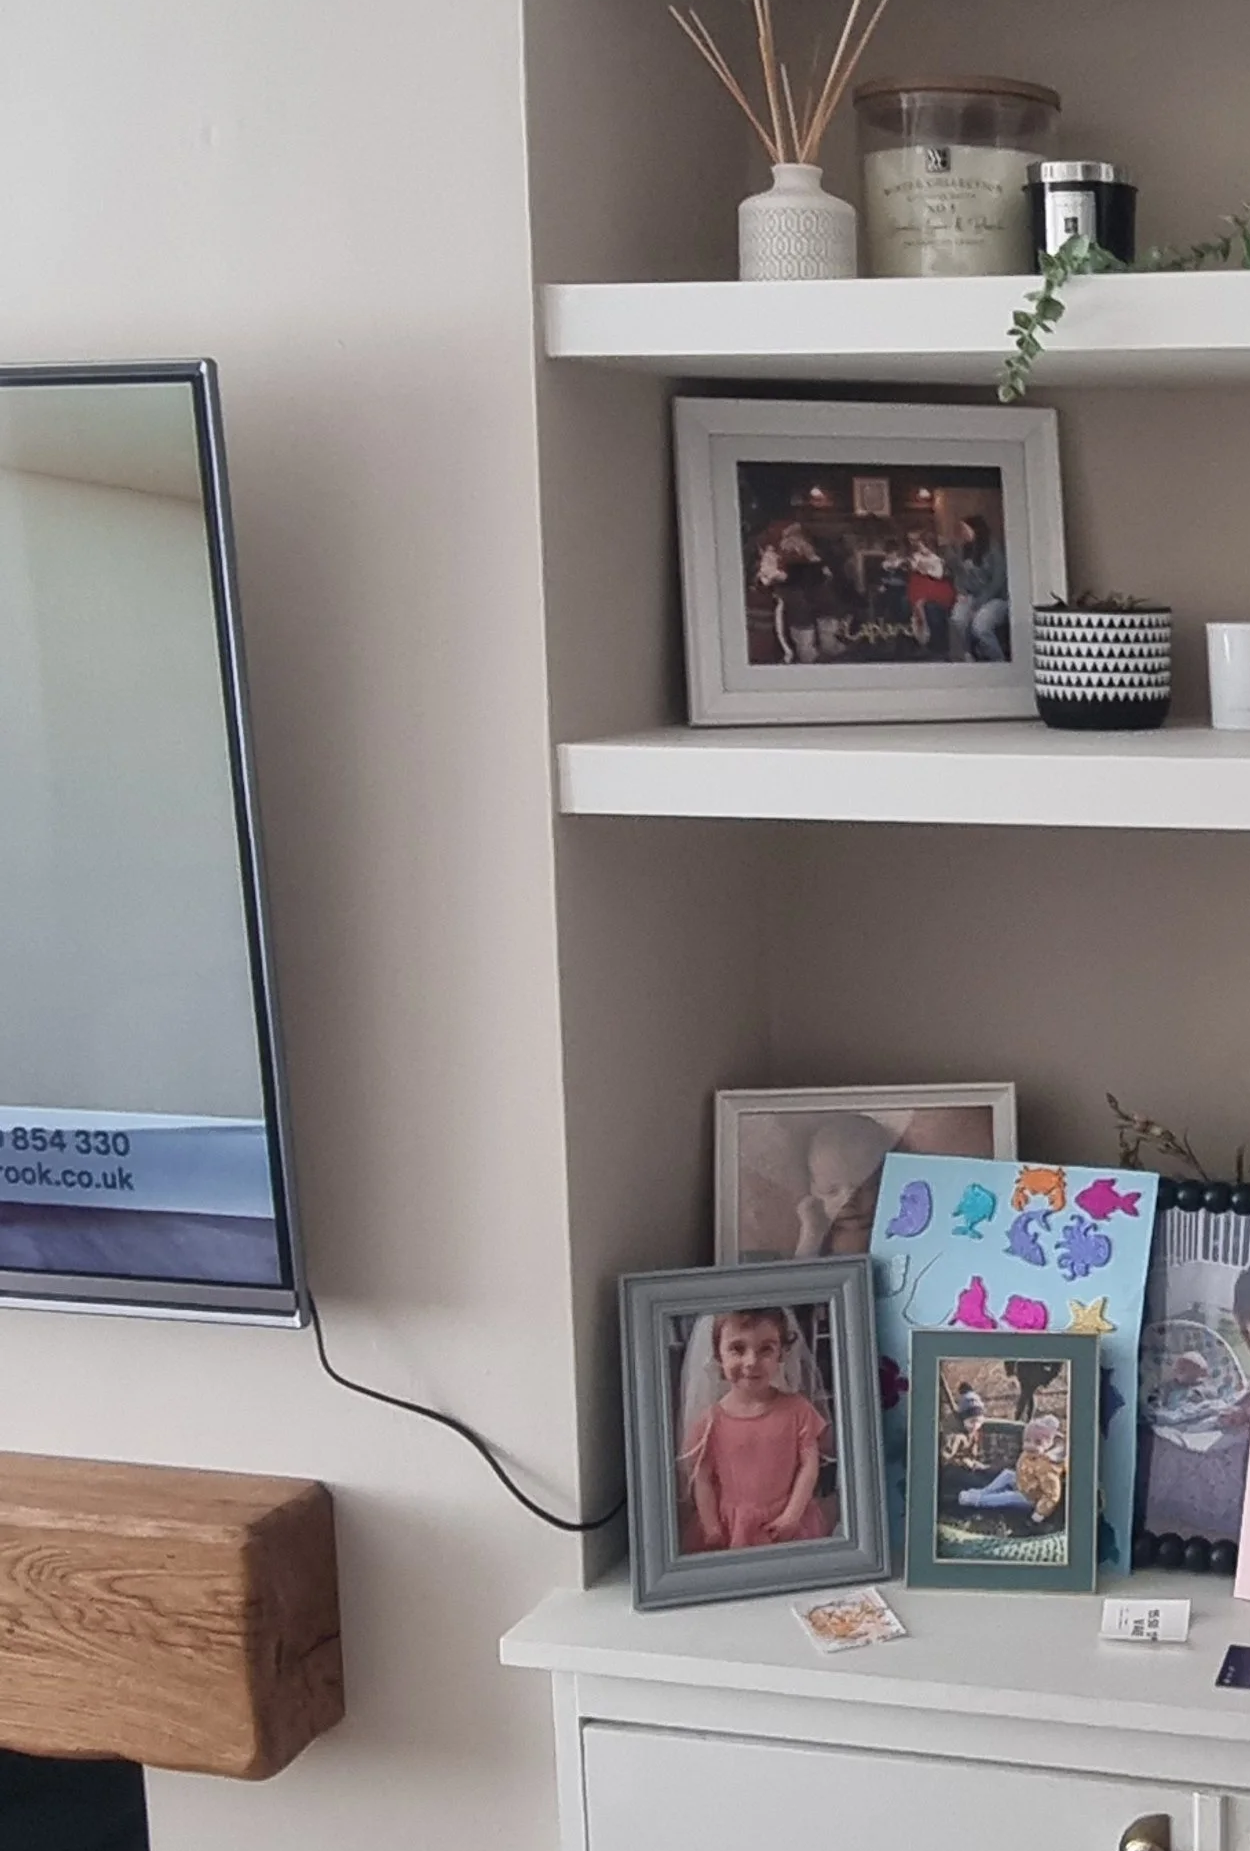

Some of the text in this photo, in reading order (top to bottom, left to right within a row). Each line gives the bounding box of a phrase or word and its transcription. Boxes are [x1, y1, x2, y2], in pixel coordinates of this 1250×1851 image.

[12, 1126, 131, 1157] 854 330
[0, 1161, 135, 1191] ook.co.uk
